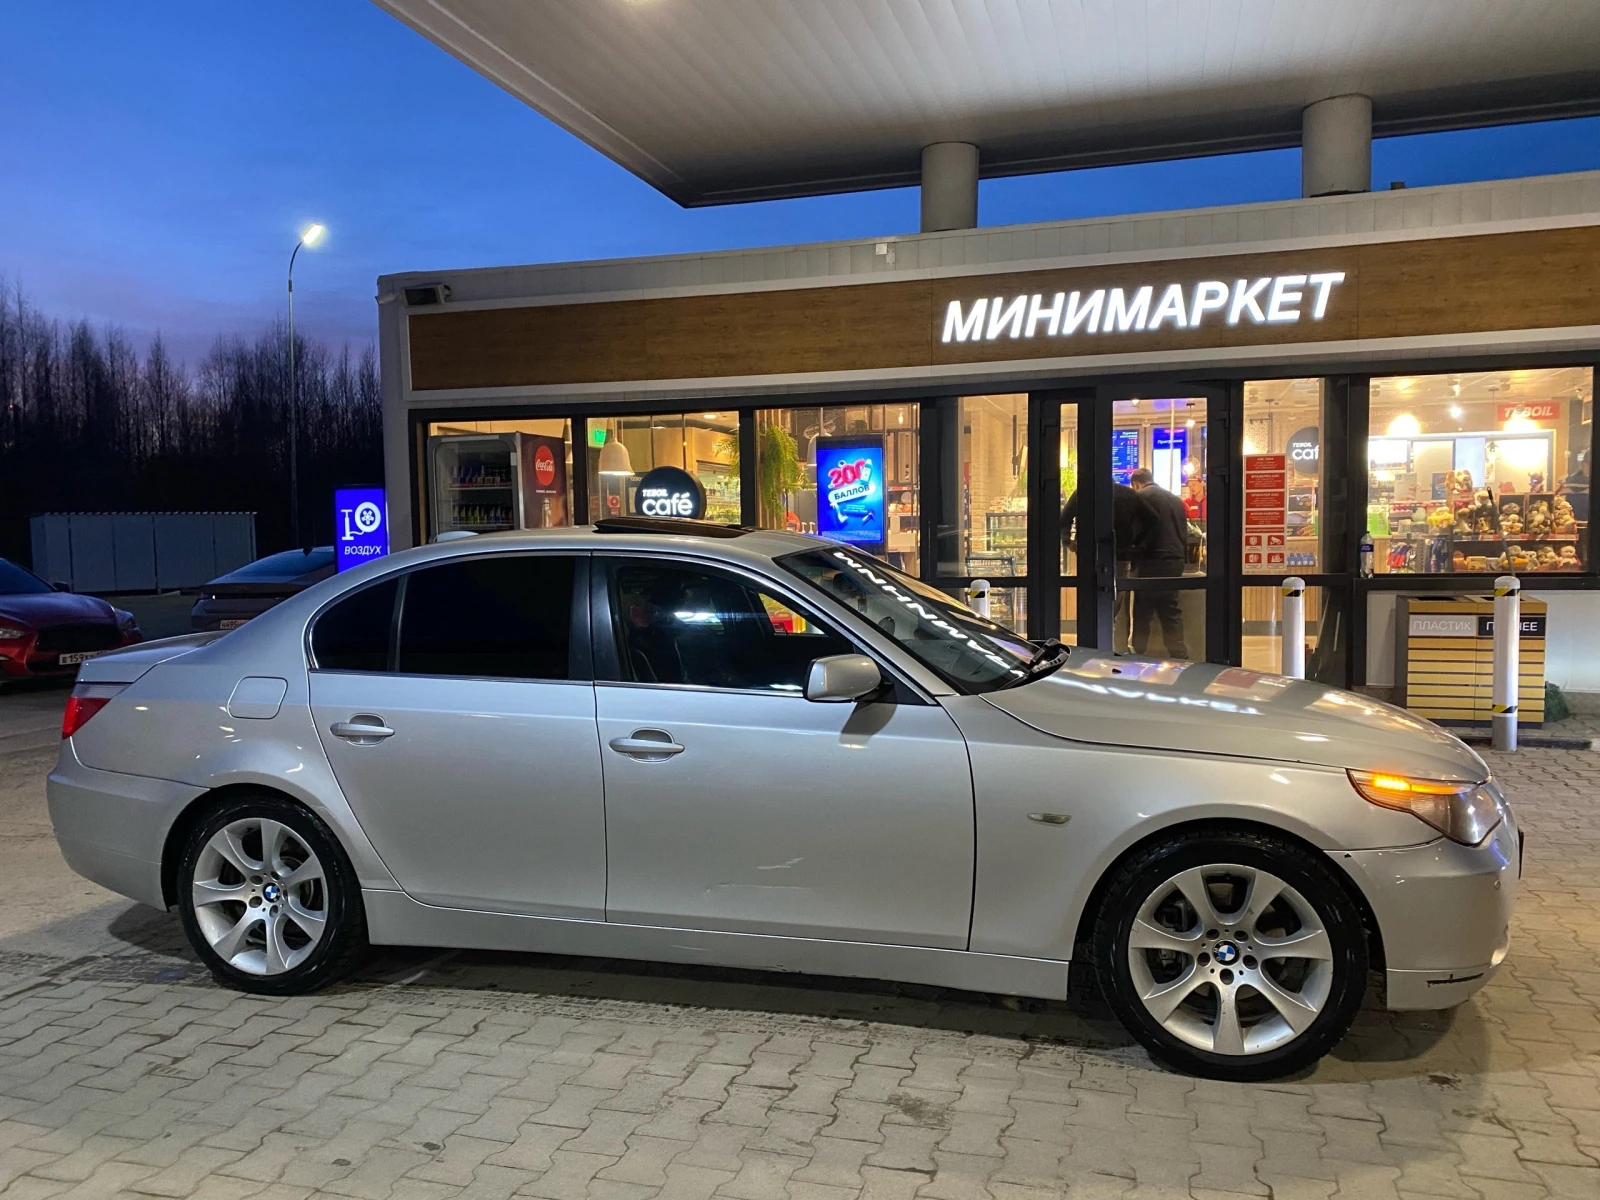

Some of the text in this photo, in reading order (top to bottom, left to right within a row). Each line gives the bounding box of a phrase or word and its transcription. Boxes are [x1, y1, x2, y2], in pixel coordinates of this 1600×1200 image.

[941, 271, 1346, 344] МИНИМАРКЕТ
[1292, 444, 1320, 460] caf
[834, 484, 870, 501] БАЛЛОВ
[642, 492, 693, 516] café
[344, 545, 382, 556] ВОЗДУХ
[1413, 620, 1472, 631] ПЛАСТИК
